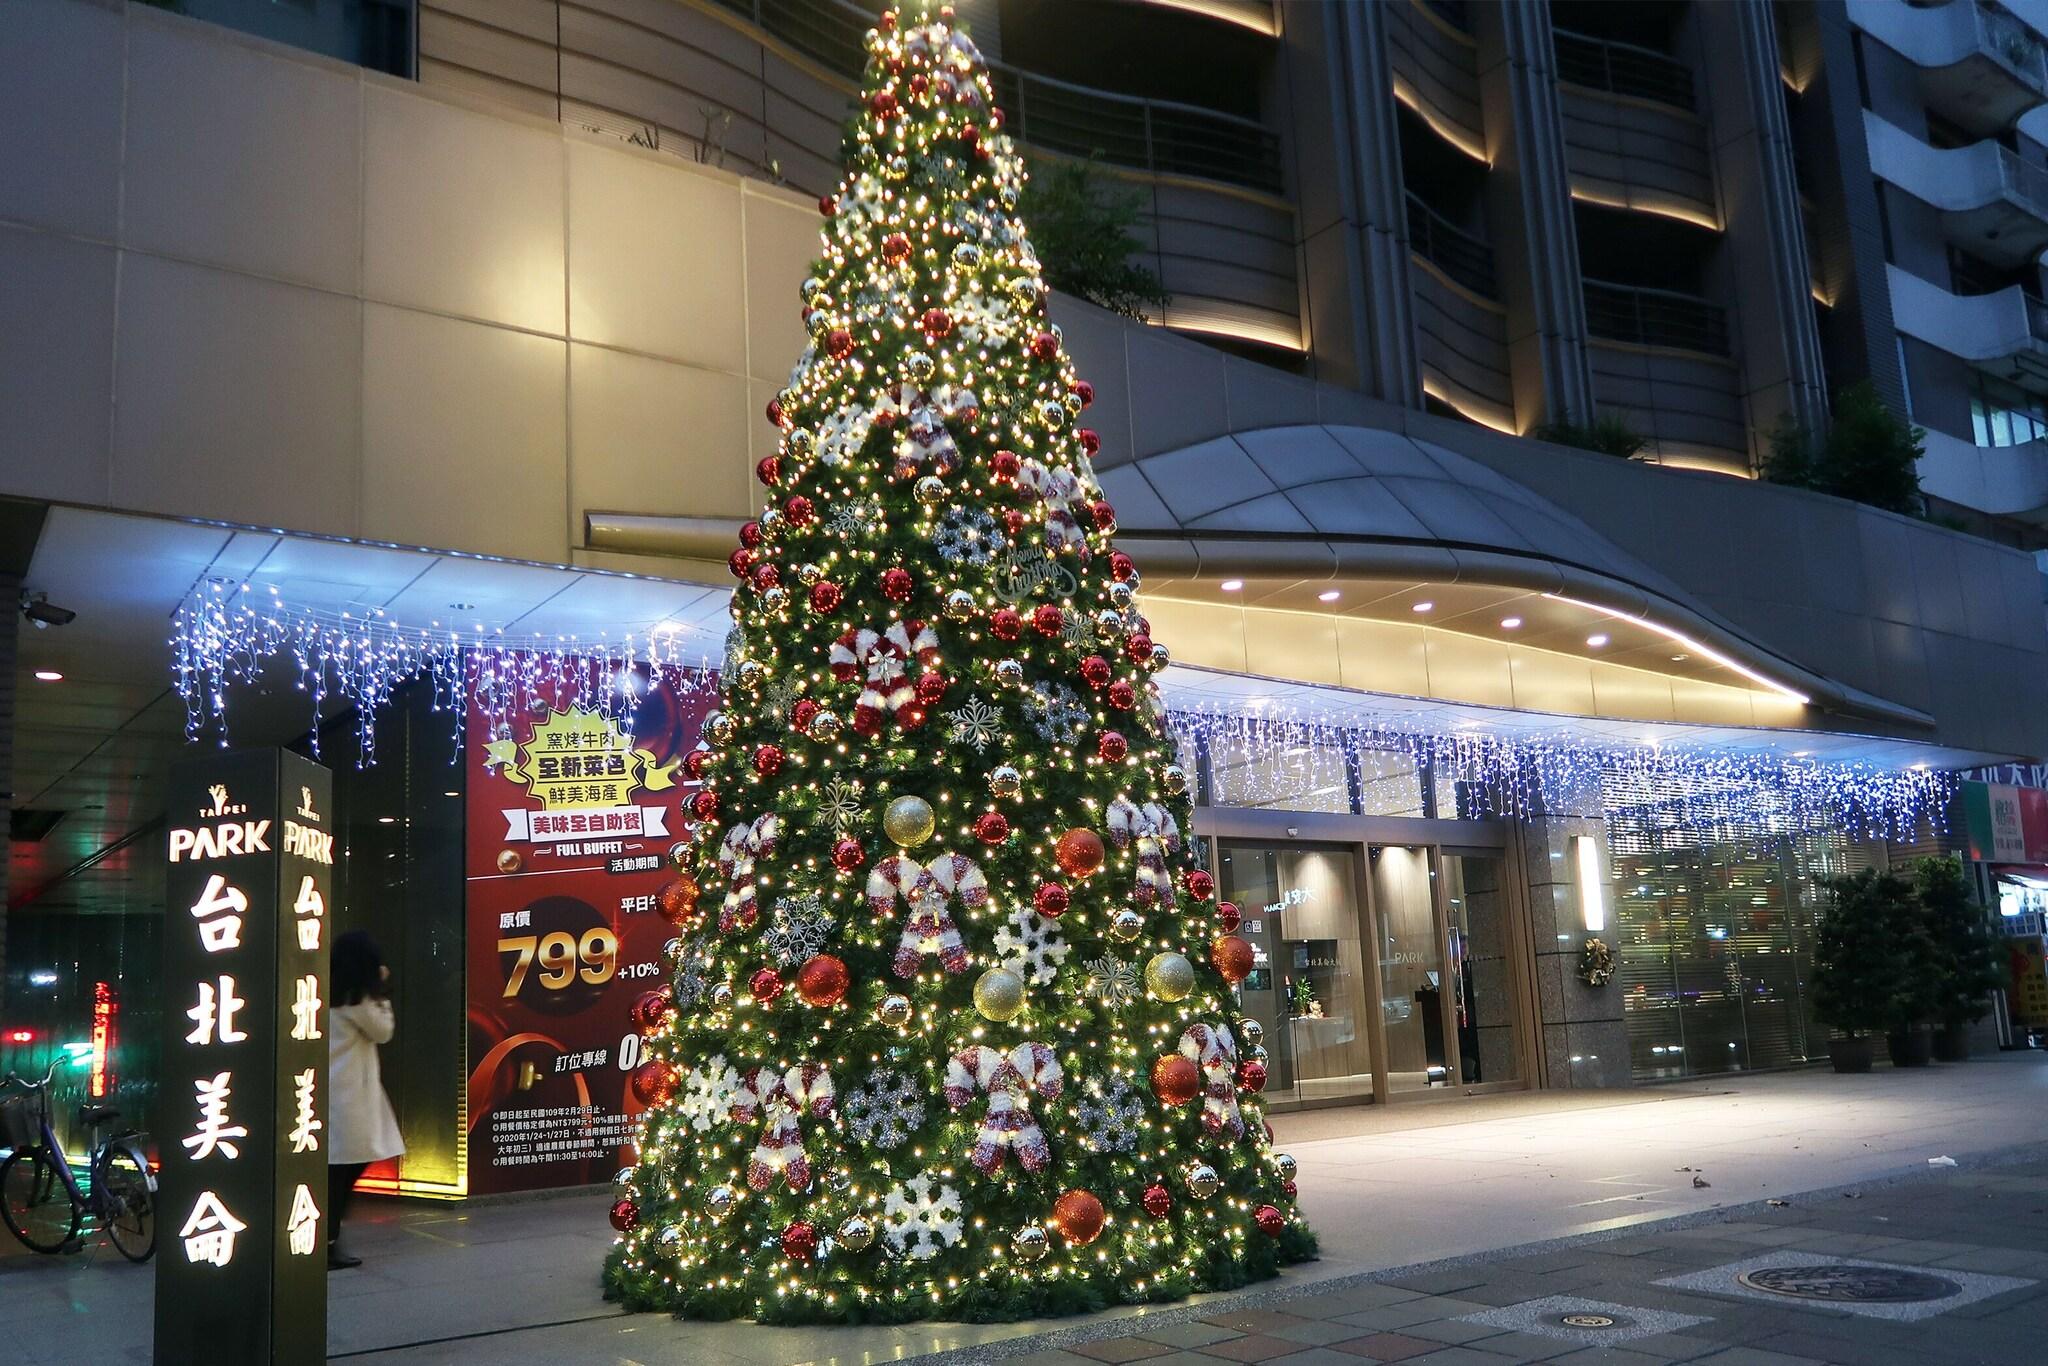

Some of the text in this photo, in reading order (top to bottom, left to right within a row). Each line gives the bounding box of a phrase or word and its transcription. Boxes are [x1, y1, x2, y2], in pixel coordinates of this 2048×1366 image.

[546, 731, 615, 749] 窯烤牛肉
[538, 754, 626, 779] 全新菜色
[548, 784, 618, 804] 鮮美海產
[199, 803, 247, 817] TAIPEI
[533, 812, 641, 834] 美味全自助餐
[169, 819, 272, 862] PARK
[284, 820, 333, 864] PARK
[556, 841, 623, 857] FULL BUFFET
[611, 856, 659, 872] 活動期間
[499, 911, 531, 929] 原價
[497, 927, 618, 998] 799
[1395, 952, 1424, 964] PARK
[618, 962, 659, 980] +10%
[554, 1048, 607, 1073] 訂位專線
